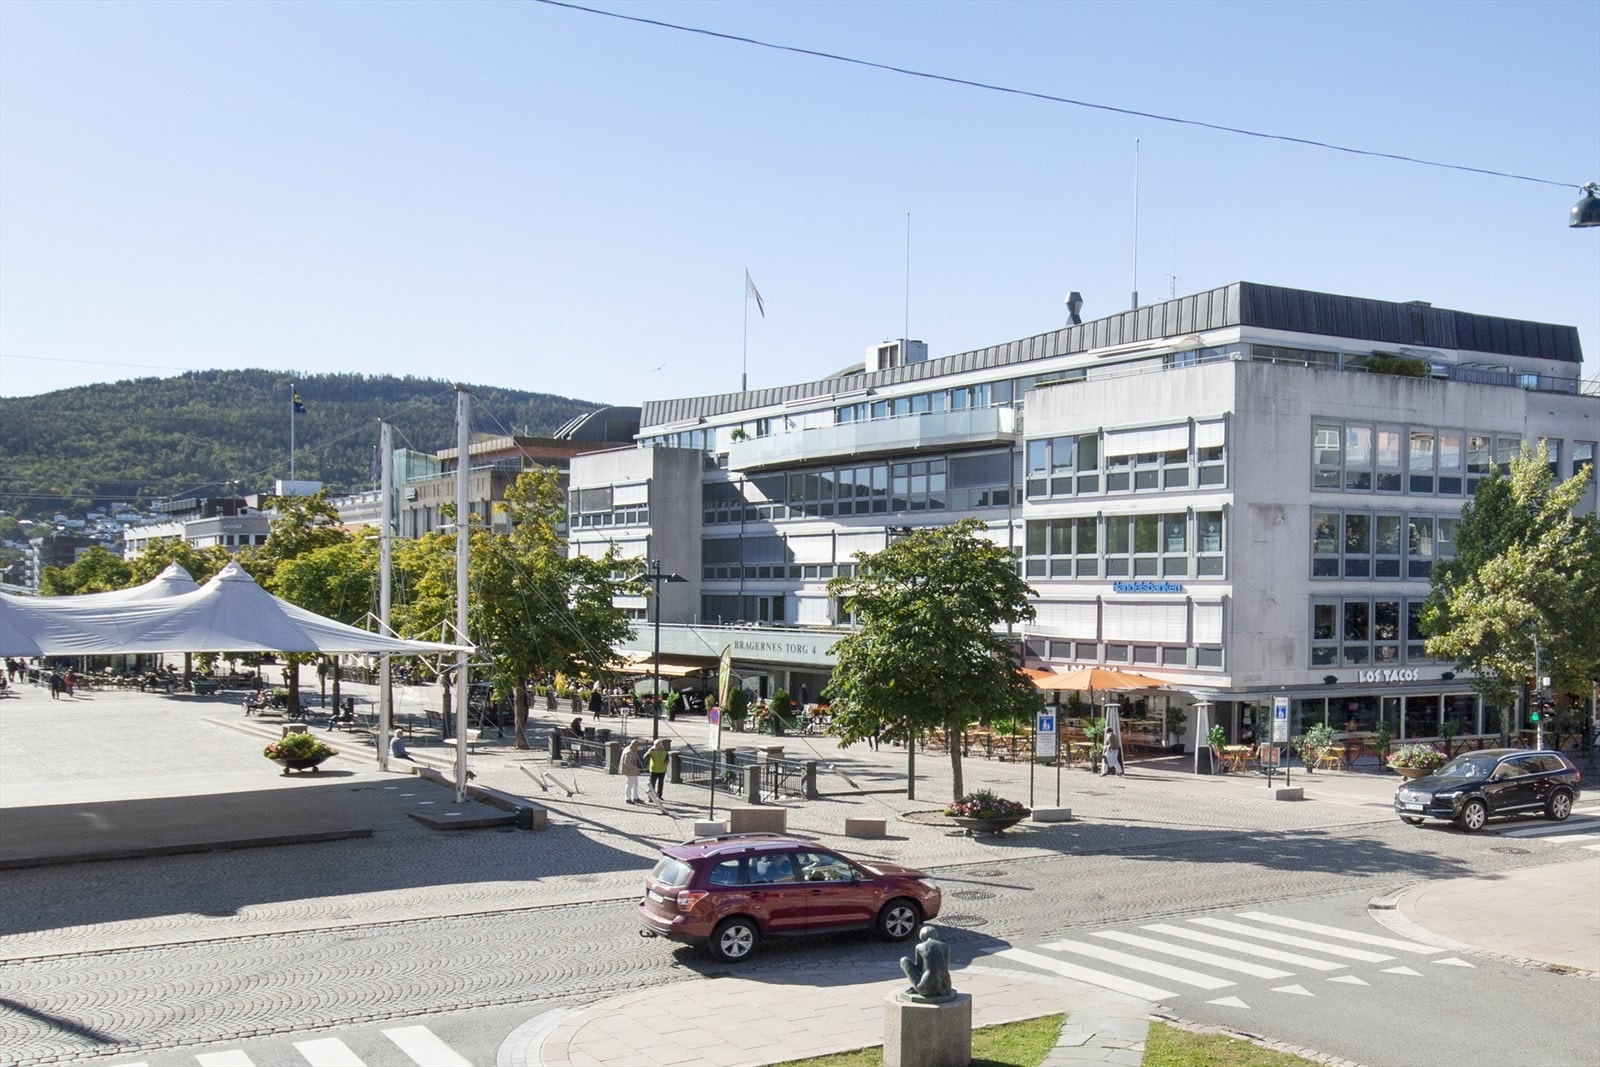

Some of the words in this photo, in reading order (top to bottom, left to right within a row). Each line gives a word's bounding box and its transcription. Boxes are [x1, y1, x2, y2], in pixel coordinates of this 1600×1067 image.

[1113, 581, 1182, 592] Handelsbanken
[734, 640, 782, 652] BRAGERNES
[785, 643, 808, 654] TORG
[811, 645, 816, 654] 4
[1359, 669, 1381, 683] LOS
[1383, 667, 1419, 682] TACOS
